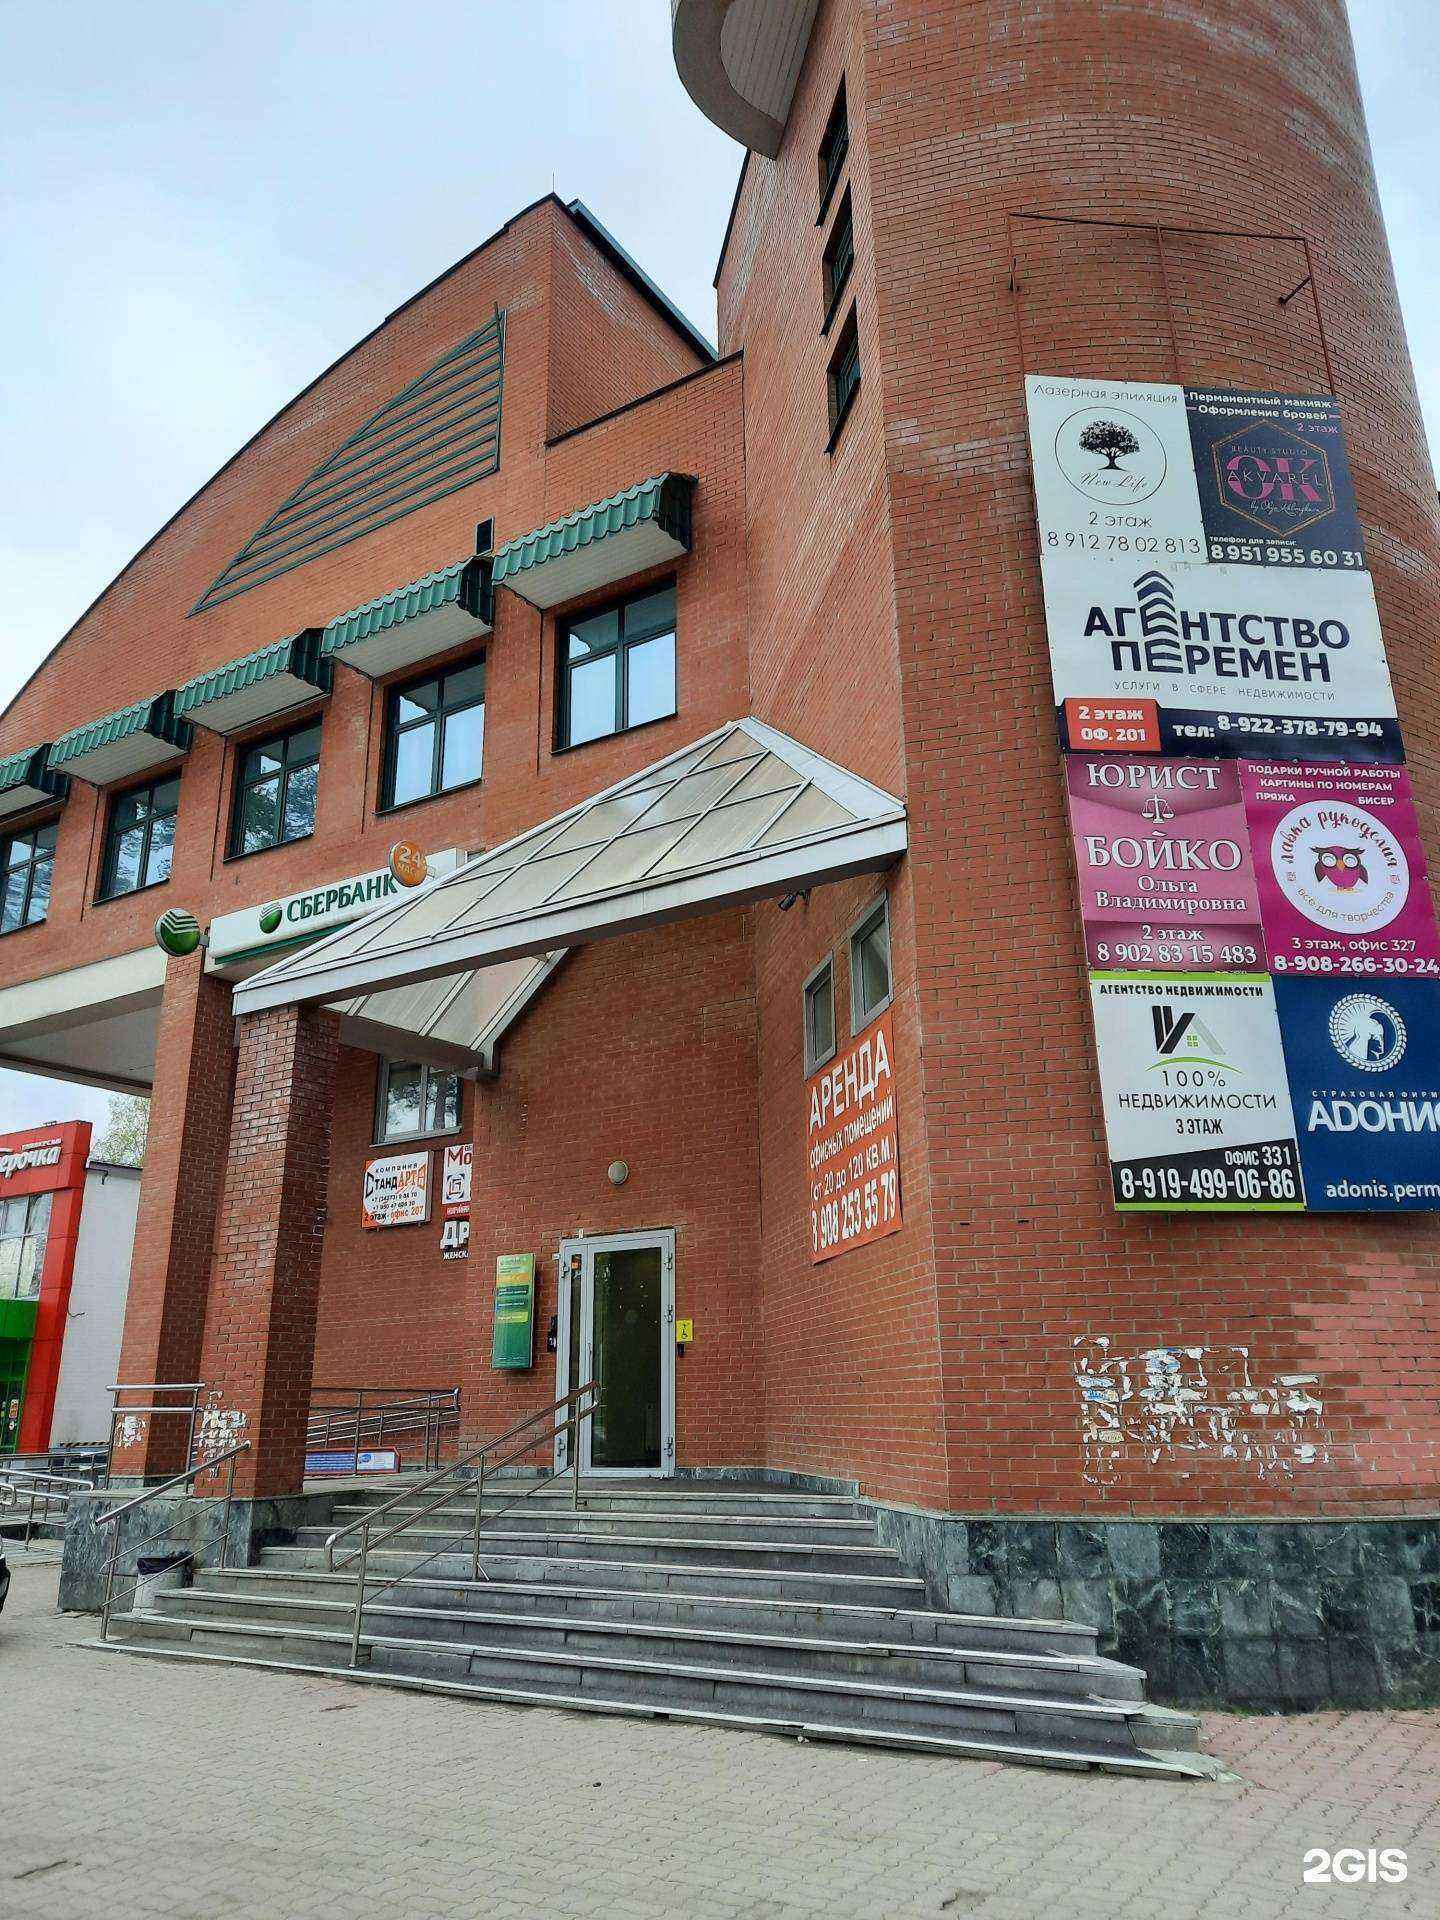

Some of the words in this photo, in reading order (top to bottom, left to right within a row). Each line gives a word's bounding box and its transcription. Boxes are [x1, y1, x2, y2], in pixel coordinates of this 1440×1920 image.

[1033, 384, 1107, 399] Лазерная
[1111, 391, 1177, 404] эпиляция
[1189, 391, 1281, 406] Перманентный
[1284, 397, 1331, 408] макияж
[1198, 405, 1279, 418] Оформление
[1283, 409, 1328, 421] бровей
[1308, 425, 1338, 434] этаж
[1080, 472, 1111, 487] New
[1113, 474, 1147, 492] Life
[1227, 470, 1325, 489] AKVAREL
[1089, 511, 1098, 525] 2
[1104, 514, 1152, 528] этаж
[1048, 531, 1059, 547] 8
[1065, 533, 1100, 550] 912
[1107, 535, 1129, 551] 78
[1135, 536, 1159, 553] 02
[1165, 538, 1200, 554] 813
[1209, 536, 1246, 545] телефон
[1211, 545, 1223, 559] 8
[1226, 546, 1262, 561] 951
[1266, 547, 1306, 563] 955
[1310, 550, 1338, 565] 60
[1341, 551, 1363, 566] 31
[1084, 600, 1350, 649] АГЕНТСТВО
[1111, 638, 1331, 682] ПЕРЕМЕН
[1114, 680, 1160, 691] УСЛУГИ
[1172, 683, 1179, 692] В
[1189, 684, 1226, 695] СФЕРЕ
[1238, 687, 1336, 701] НЕДВИЖИМОСТИ
[1078, 706, 1090, 720] 2
[1094, 707, 1144, 721] этаж
[1115, 728, 1146, 742] 201
[1172, 723, 1215, 738] тел:
[1216, 715, 1383, 738] 8-922-378-79-94
[1086, 763, 1220, 790] ЮРИСТ
[1248, 765, 1302, 775] ПОДАРКИ
[1305, 766, 1350, 777] РУЧНОЙ
[1354, 769, 1400, 779] РАБОТЫ
[1260, 778, 1314, 789] КАРТИНЫ
[1317, 780, 1334, 789] ПО
[1336, 781, 1393, 791] НОМЕРАМ
[1256, 792, 1296, 802] ПРЯЖА
[1358, 796, 1395, 805] БИСЕР
[1084, 830, 1242, 871] БОЙКО
[1137, 875, 1199, 893] Ольга
[286, 872, 398, 922] СБЕРБАНК
[1096, 891, 1247, 915] Владимировна
[1316, 905, 1338, 919] для
[1339, 891, 1394, 922] творчества
[1142, 925, 1153, 940] 2
[1157, 929, 1205, 941] этаж
[1097, 943, 1110, 961] 8
[1115, 944, 1154, 962] 902
[1158, 945, 1183, 963] 83
[1188, 946, 1214, 964] 15
[1220, 946, 1257, 964] 483
[1291, 938, 1301, 949] 3
[1304, 940, 1346, 953] этаж,
[1349, 938, 1388, 955] офис
[1391, 939, 1416, 951] 327
[1274, 955, 1440, 974] 8-908-266-30-24
[1100, 984, 1163, 996] АГЕНТСТВО
[1165, 985, 1264, 997] НЕДВИЖИМОСТИ
[809, 1029, 892, 1136] АРЕНДА
[1162, 1070, 1226, 1087] 100%
[1119, 1093, 1277, 1111] НЕДВИЖИМОСТИ
[1312, 1090, 1394, 1098] СТРАХОВАЯ
[810, 1131, 843, 1171] офисных
[844, 1087, 893, 1147] помещений
[1176, 1118, 1184, 1134] 3
[1187, 1118, 1224, 1134] ЭТАЖ
[1225, 1150, 1259, 1166] ОФИС
[1262, 1145, 1292, 1166] 331
[824, 1171, 834, 1196] 20
[835, 1168, 847, 1194] до
[848, 1152, 864, 1181] 120
[1120, 1167, 1296, 1199] 8-919-499-06-86
[391, 1208, 409, 1220] офис
[411, 1205, 424, 1216] 207
[811, 1204, 819, 1253] 8
[821, 1200, 840, 1249] 908
[841, 1187, 862, 1241] 253
[864, 1178, 878, 1230] 55
[881, 1168, 896, 1223] 79
